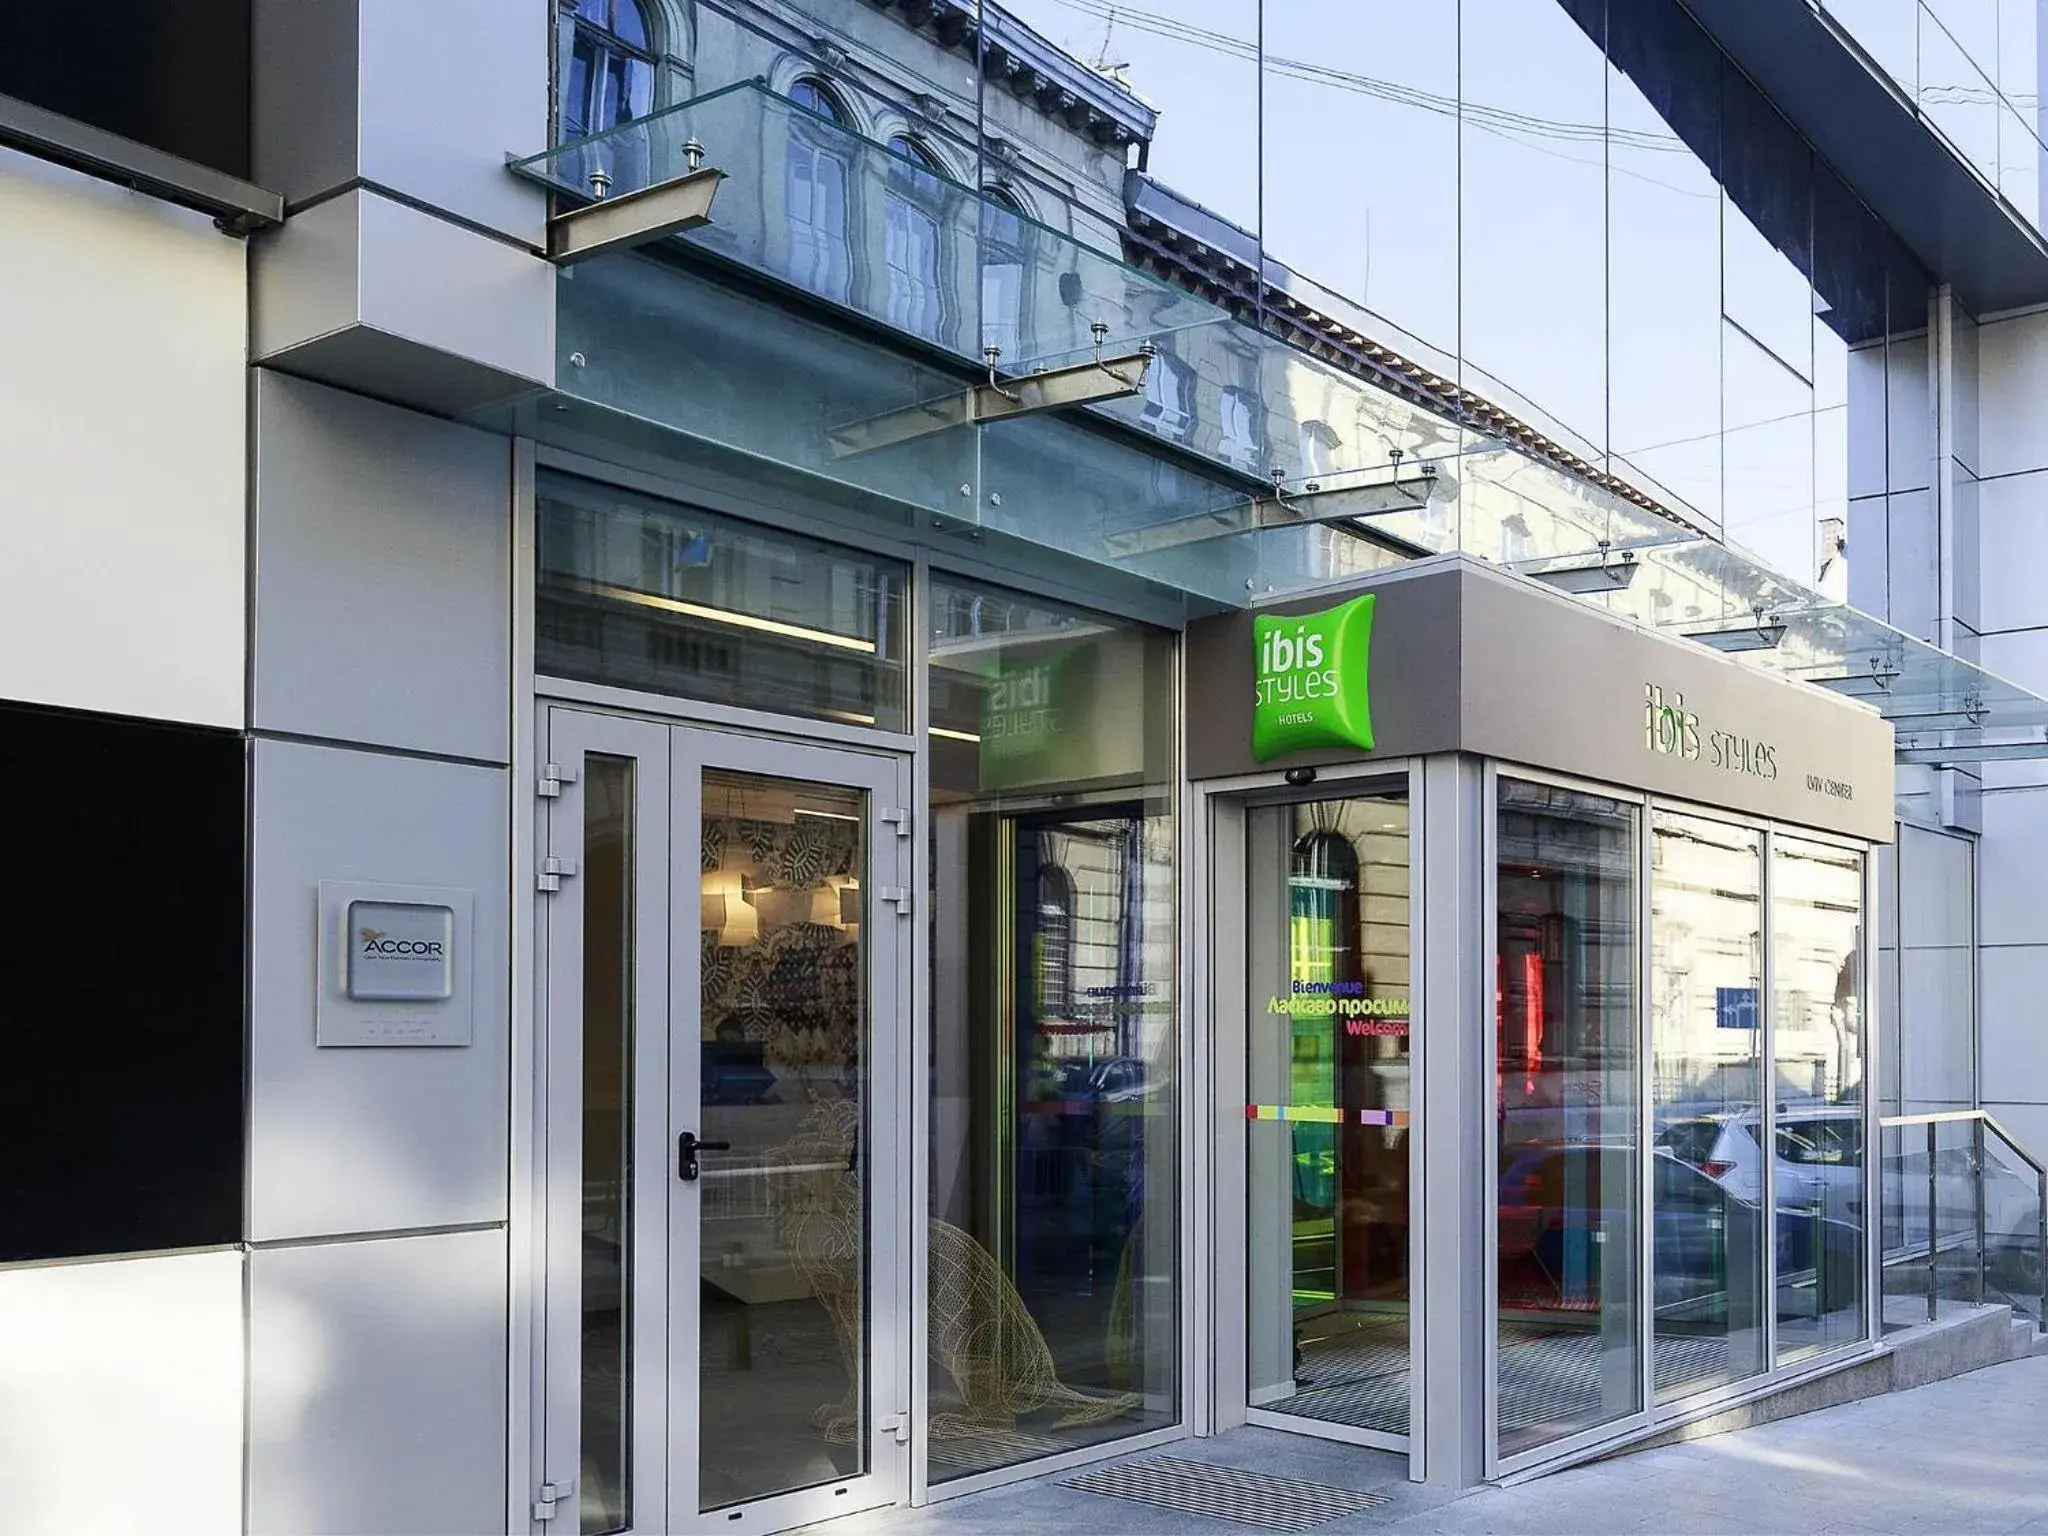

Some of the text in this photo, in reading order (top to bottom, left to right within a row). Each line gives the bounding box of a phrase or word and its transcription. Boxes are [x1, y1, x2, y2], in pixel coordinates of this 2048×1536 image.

[1262, 626, 1324, 674] ibis
[1278, 711, 1313, 725] HOTELS
[1644, 682, 1701, 761] ibis
[364, 939, 444, 955] ACCOR
[1292, 979, 1363, 994] Bienvenue
[1338, 998, 1410, 1018] просим
[1346, 1020, 1409, 1036] Welcom
